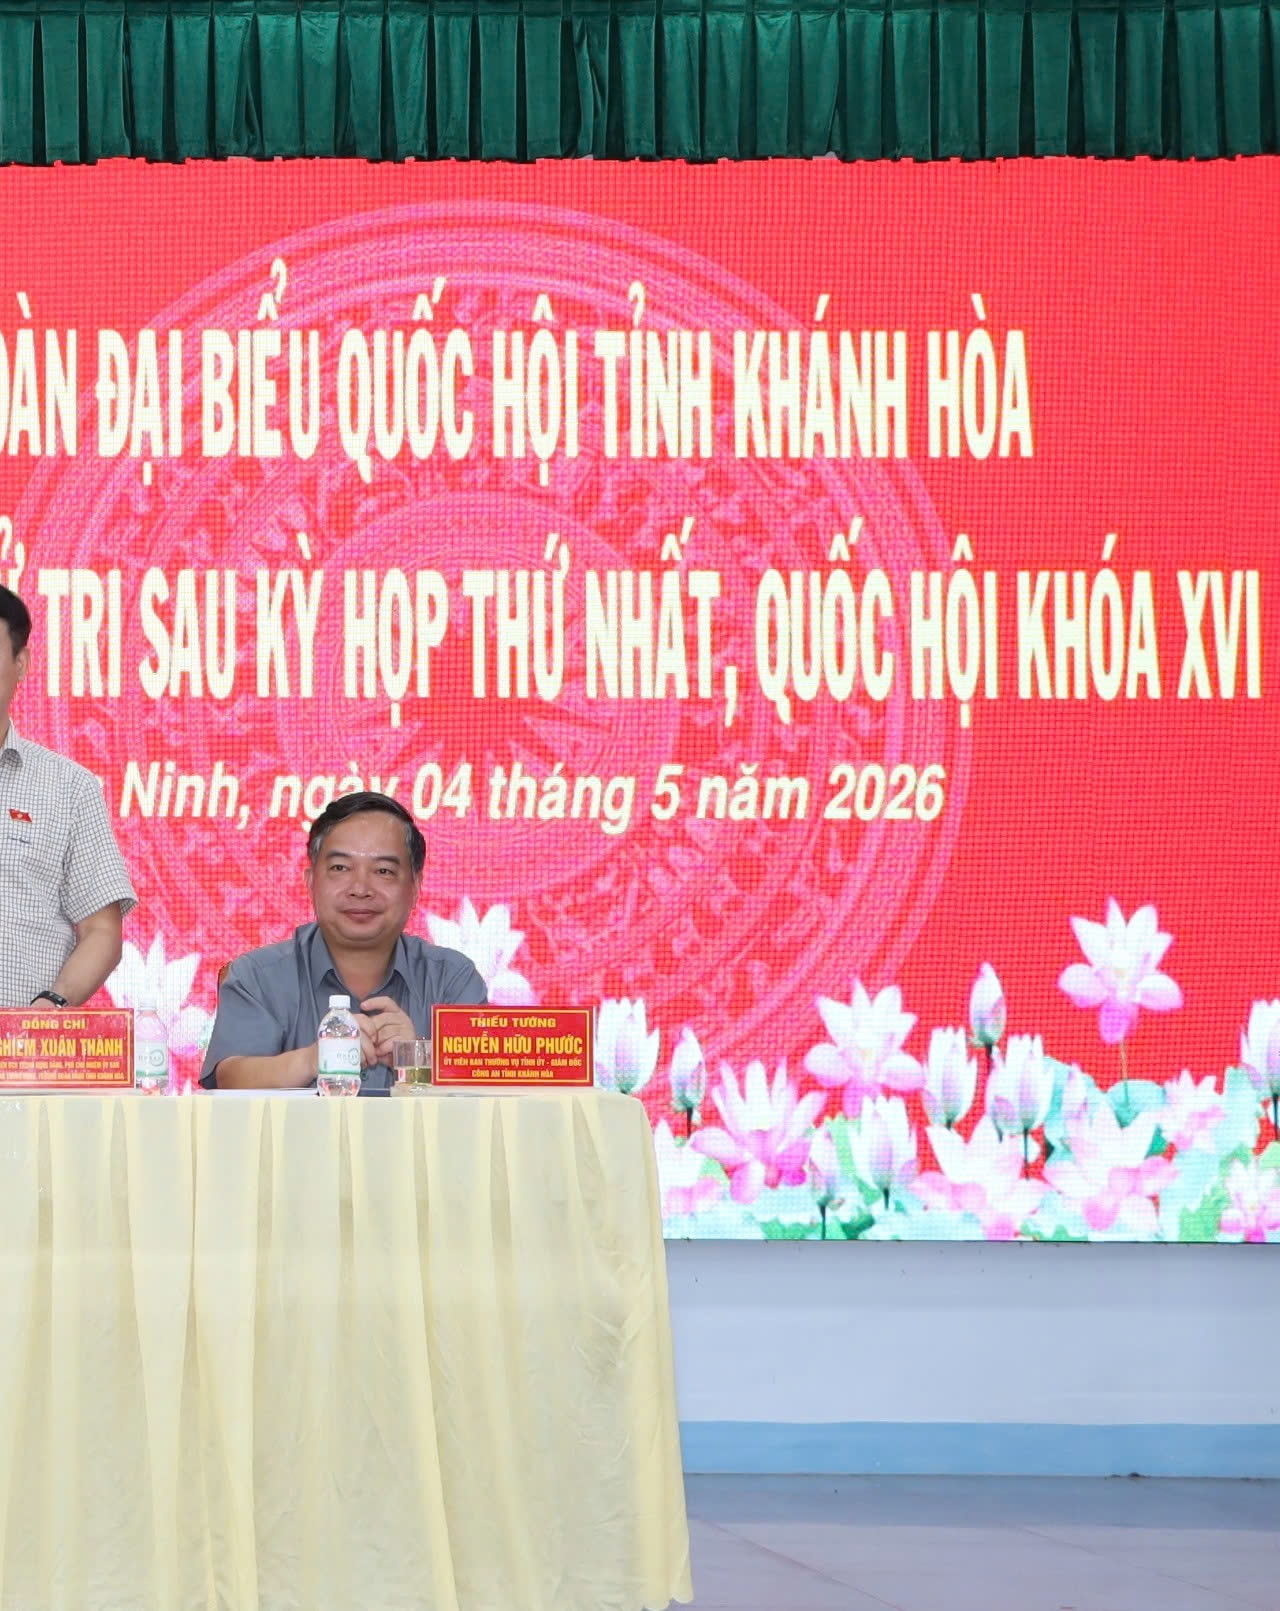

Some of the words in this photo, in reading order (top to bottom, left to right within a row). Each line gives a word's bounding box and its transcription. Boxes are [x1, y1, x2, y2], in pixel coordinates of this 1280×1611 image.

[95, 329, 183, 485] ĐẠI
[202, 258, 320, 459] BIỂU
[337, 276, 474, 483] QUỐC
[493, 294, 579, 486] HỘI
[594, 281, 712, 458] TỈNH
[734, 294, 907, 458] KHÁNH
[928, 293, 1033, 459] HÒA
[37, 568, 121, 698] TRI
[138, 567, 237, 699] SAU
[256, 533, 324, 698] KỲ
[344, 567, 449, 727] HỌP
[462, 533, 570, 701] THỨ
[585, 517, 737, 726] NHẤT,
[755, 517, 893, 724] QUỐC
[910, 534, 997, 728] HỘI
[1018, 534, 1160, 700] KHÓA
[1178, 571, 1259, 699] XVI
[120, 761, 250, 829] Ninh,
[412, 762, 472, 820] 04
[489, 762, 635, 835] tháng
[651, 764, 683, 820] 5
[696, 764, 809, 820] năm
[824, 763, 945, 821] 2026
[40, 1034, 77, 1057] XUÂN
[80, 1035, 123, 1057] THÀNH
[442, 1031, 499, 1054] NGUYỄN
[503, 1033, 532, 1054] HỮU
[535, 1033, 584, 1055] PHƯỚC
[470, 1015, 508, 1028] THIẾU
[512, 1015, 556, 1028] TƯỚNG
